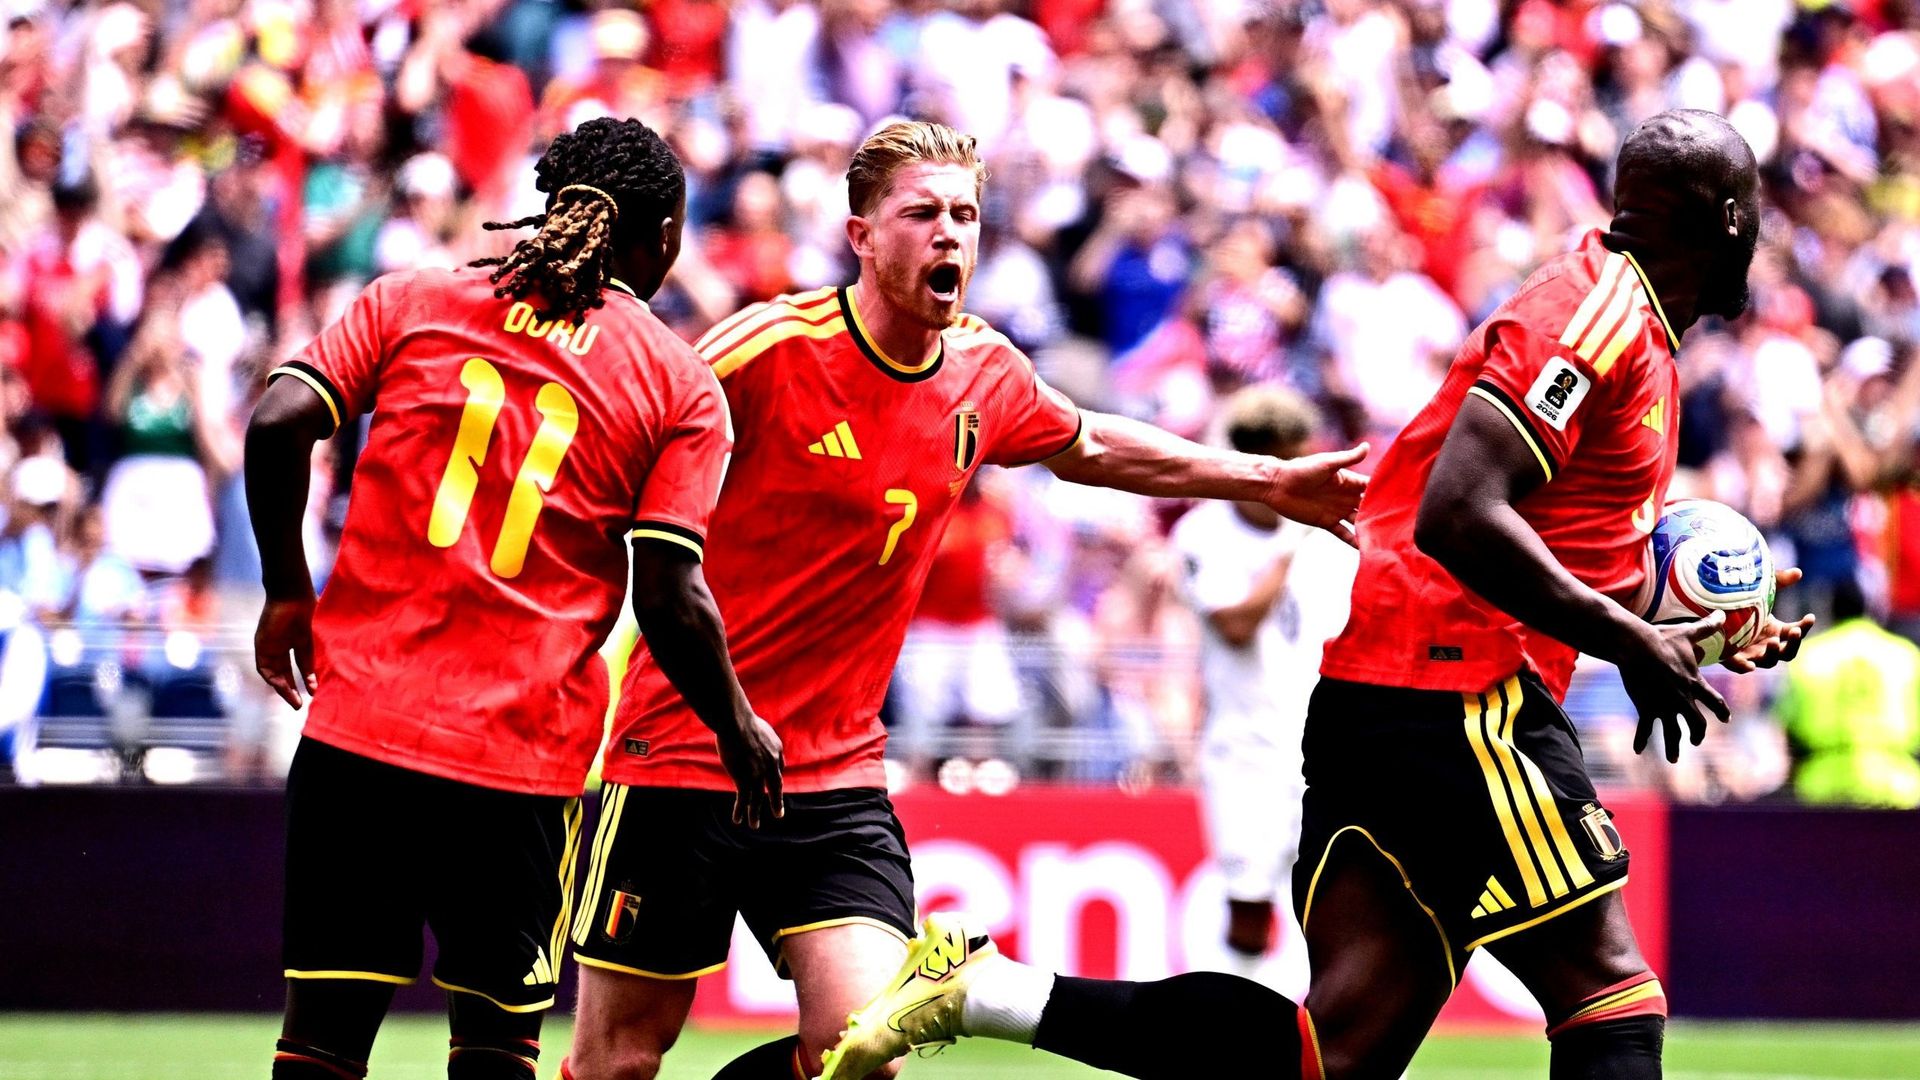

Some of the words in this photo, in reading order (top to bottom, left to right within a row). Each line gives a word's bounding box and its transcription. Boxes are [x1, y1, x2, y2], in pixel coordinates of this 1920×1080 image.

[503, 301, 600, 356] DOKU
[1536, 403, 1557, 420] 2026
[427, 357, 580, 579] 11
[878, 488, 918, 566] 7
